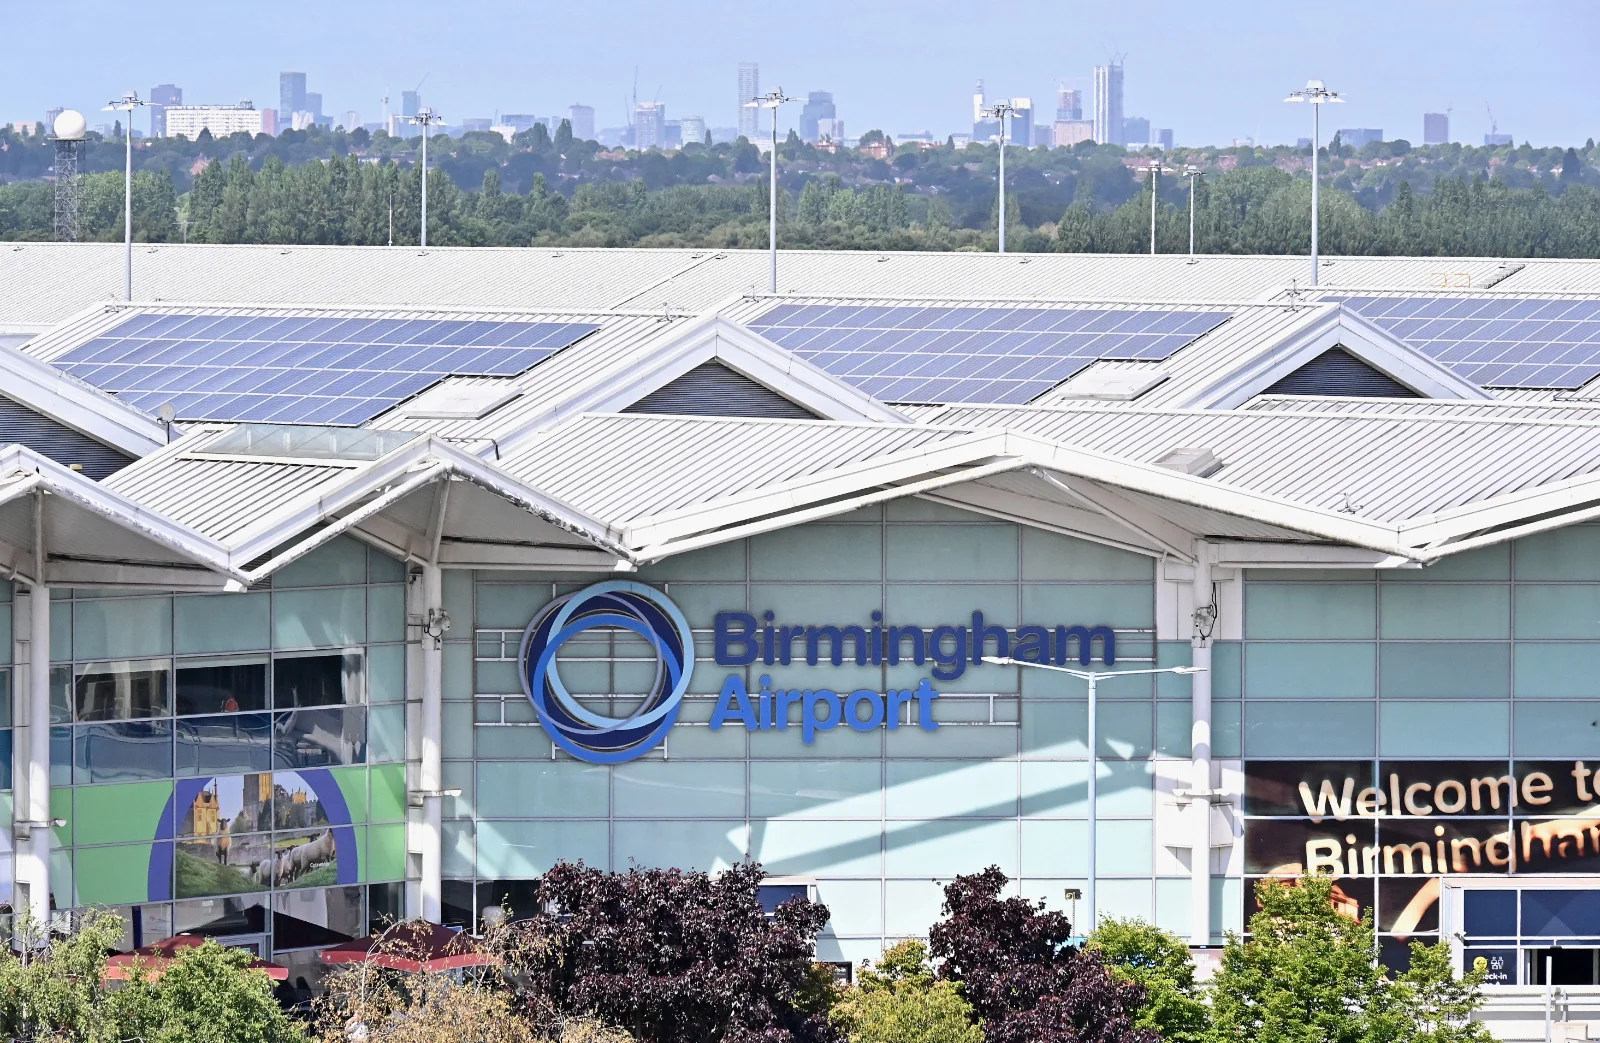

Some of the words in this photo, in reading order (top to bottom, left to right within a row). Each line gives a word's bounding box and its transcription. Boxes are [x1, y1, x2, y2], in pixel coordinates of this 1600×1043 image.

[714, 609, 1116, 681] Birmingham
[709, 674, 940, 744] Airport
[1298, 772, 1554, 824] Welcome
[1571, 760, 1600, 802] t
[1482, 972, 1508, 980] eck-in
